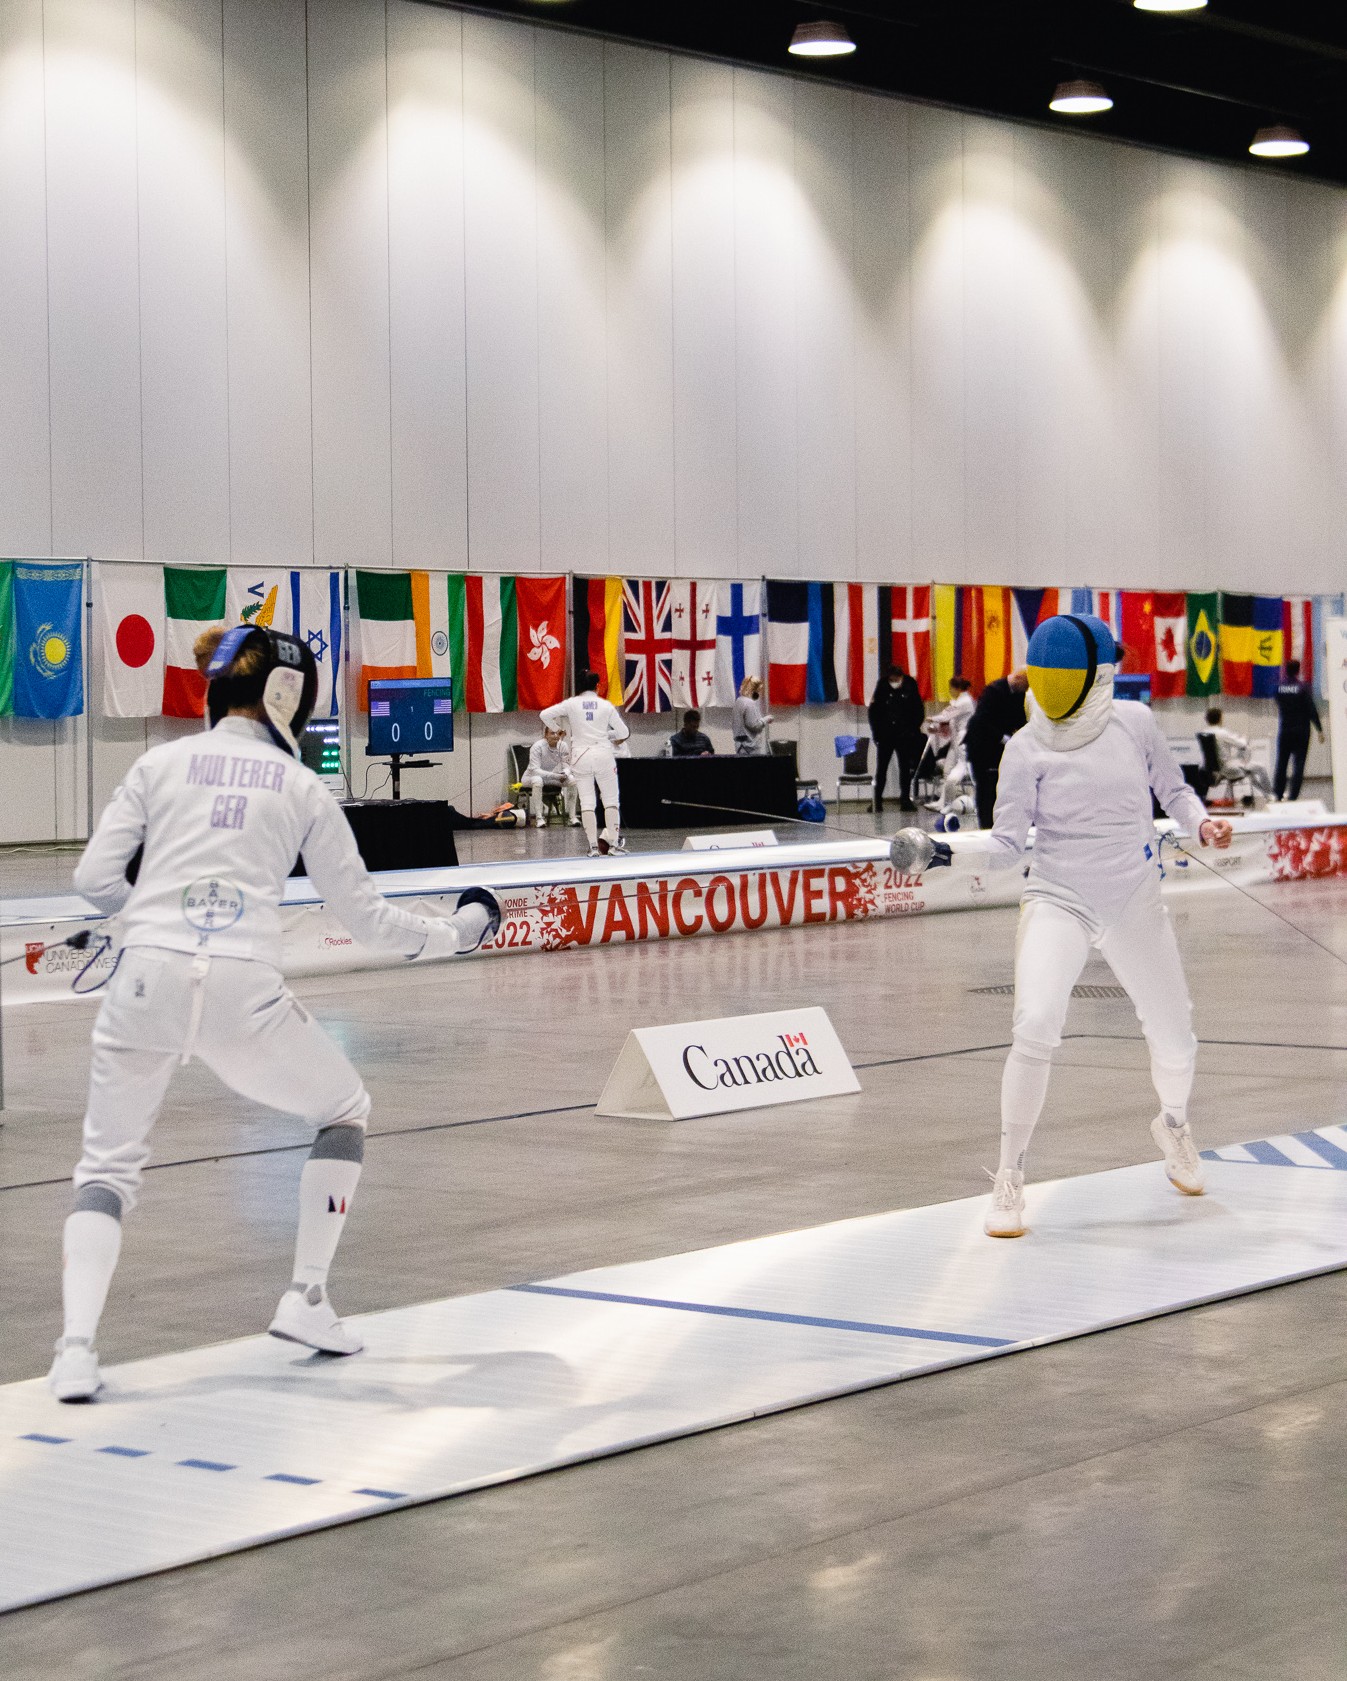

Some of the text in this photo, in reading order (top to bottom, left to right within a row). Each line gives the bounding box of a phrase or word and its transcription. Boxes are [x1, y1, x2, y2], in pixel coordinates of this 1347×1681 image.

[423, 689, 451, 697] FENCING
[391, 721, 433, 742] 0 0
[186, 754, 286, 794] MULTERER
[210, 794, 248, 830] GER
[187, 898, 238, 910] BAYER
[562, 866, 857, 946] VANCOUVER
[883, 891, 914, 902] FENCING
[885, 901, 925, 913] WORLD CUP
[682, 1035, 823, 1091] Canada
